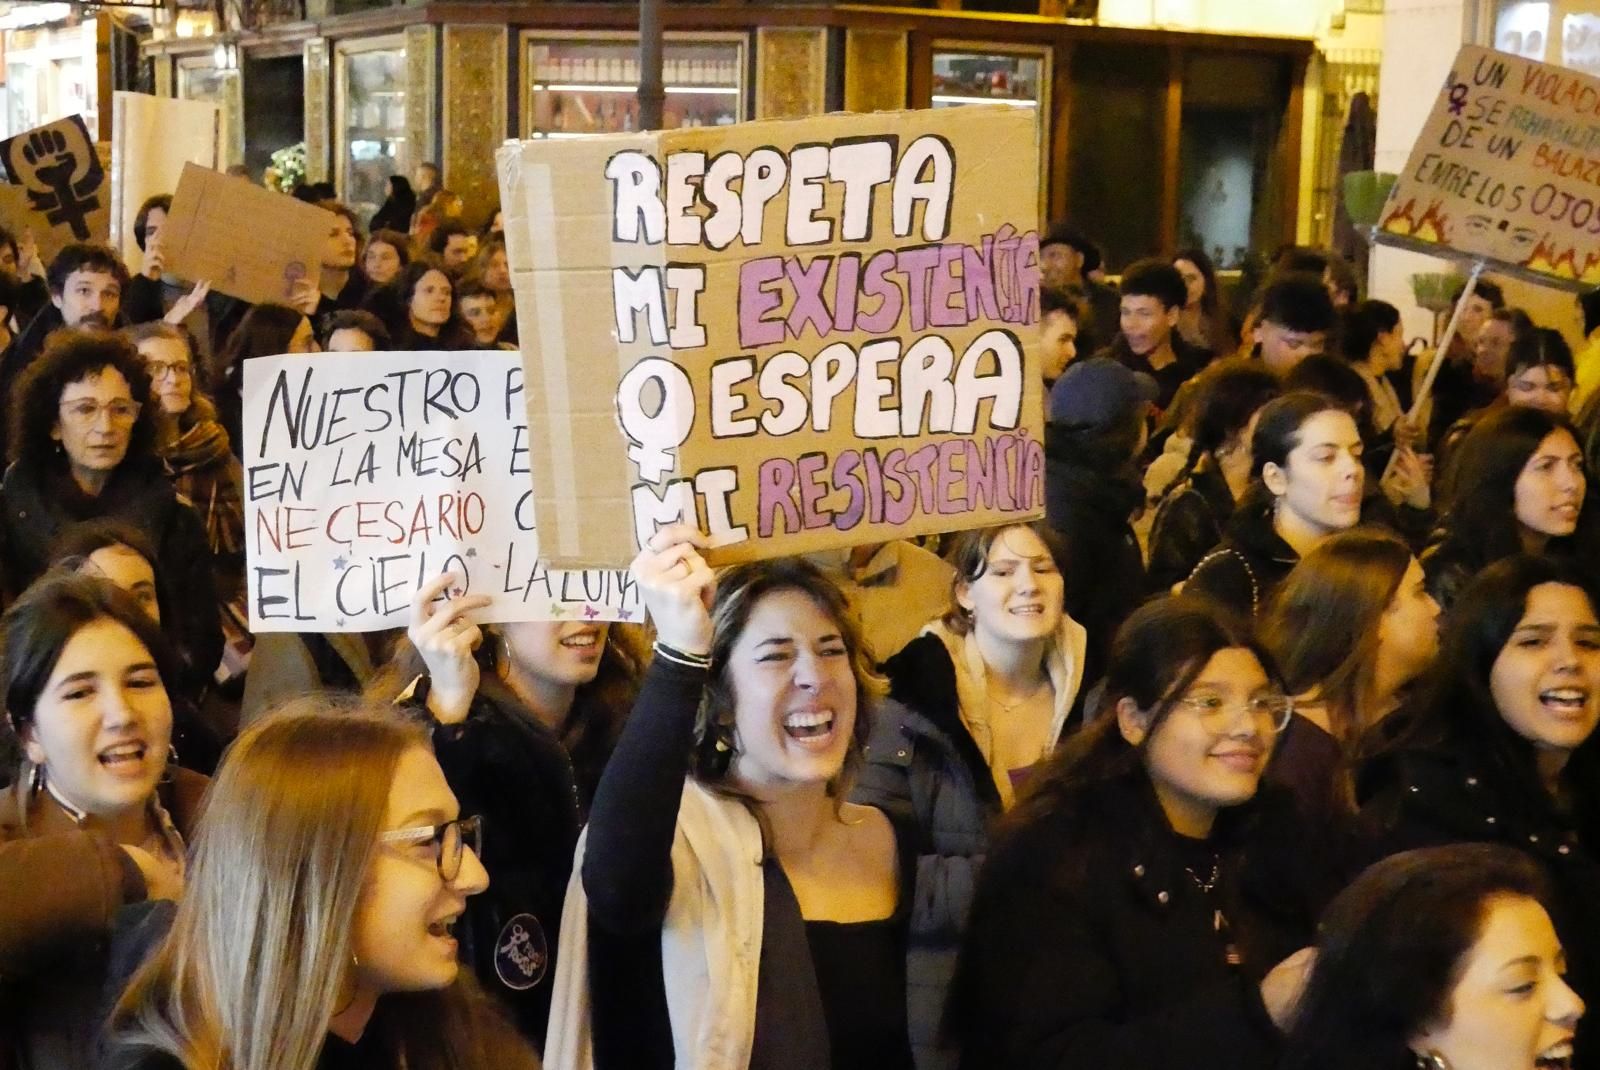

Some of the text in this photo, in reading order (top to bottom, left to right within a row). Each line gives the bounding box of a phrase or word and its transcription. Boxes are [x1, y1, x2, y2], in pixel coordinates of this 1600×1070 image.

[1467, 95, 1506, 125] SE
[1473, 54, 1600, 116] UN VIOLAD
[1414, 153, 1480, 199] ENTRE
[1475, 176, 1526, 212] LOS
[1440, 119, 1600, 187] DE UN BALAZ
[604, 133, 957, 251] RESPETA
[612, 261, 707, 350] MI
[259, 366, 481, 458] NUESTRO
[711, 328, 1025, 439] ESPERA
[247, 461, 308, 503] EN
[329, 441, 381, 487] LA
[396, 431, 487, 482] MESA
[631, 465, 750, 552] MI
[757, 428, 1045, 538] RESISTENCIA
[254, 559, 317, 621] EL
